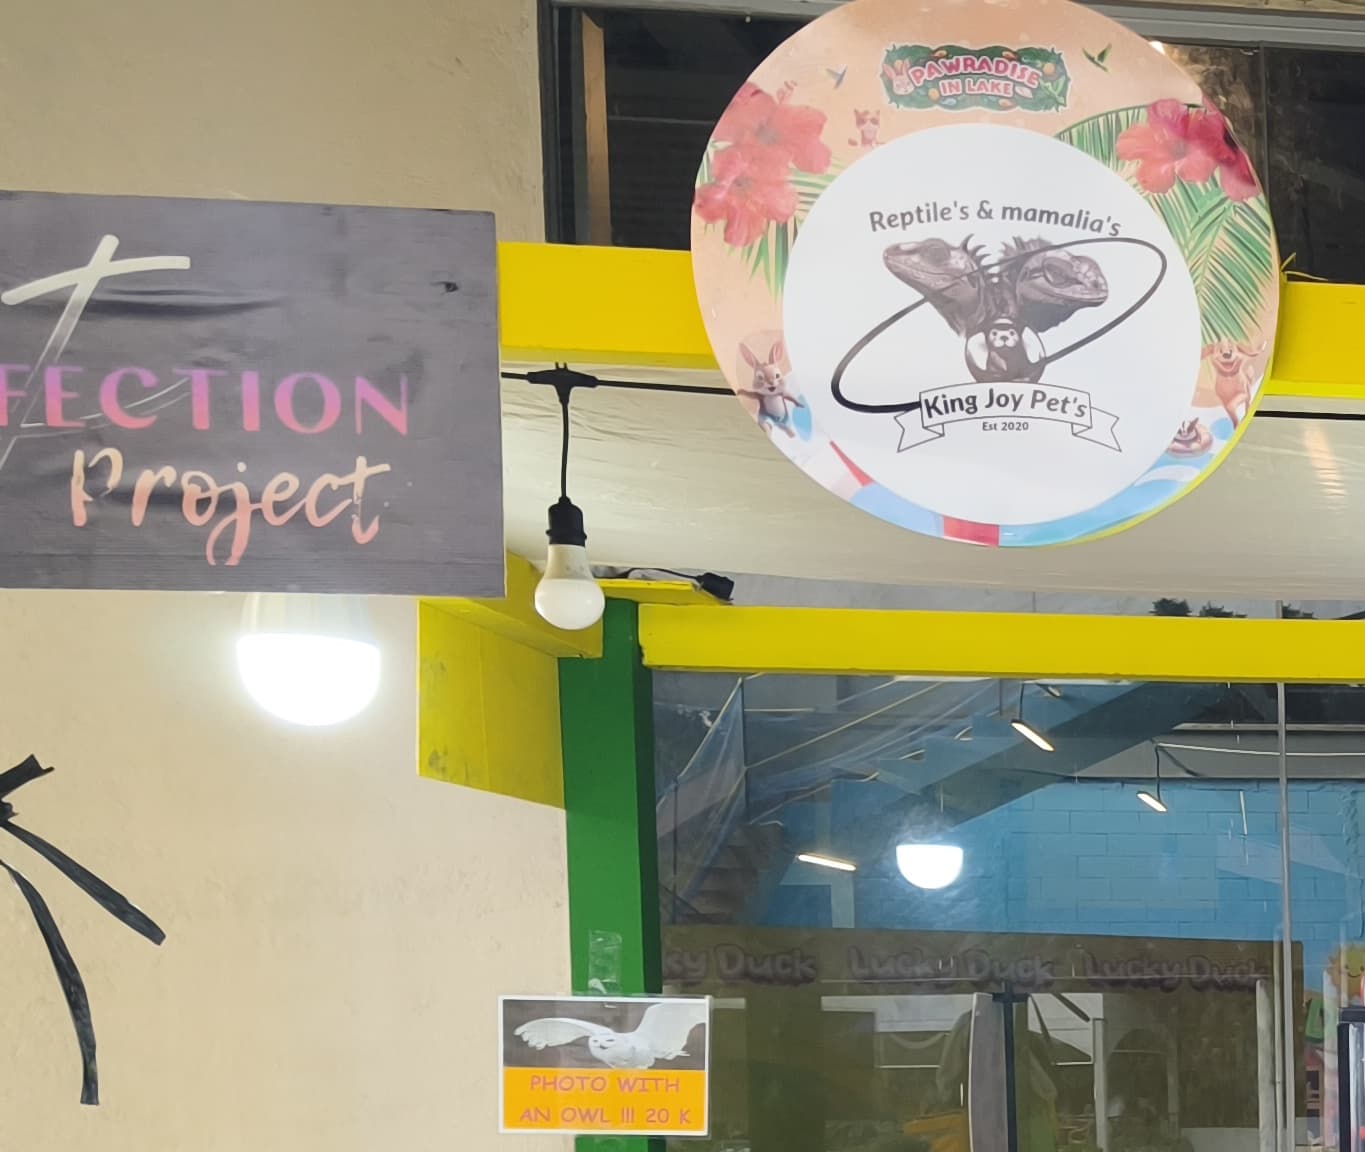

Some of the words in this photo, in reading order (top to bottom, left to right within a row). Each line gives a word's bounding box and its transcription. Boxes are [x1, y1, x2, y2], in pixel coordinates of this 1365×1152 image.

[910, 56, 1042, 86] PAWRADISE
[941, 81, 962, 95] IN
[967, 80, 1013, 96] LAKE
[869, 200, 970, 232] Reptile's
[977, 199, 993, 220] &
[1001, 204, 1121, 237] mamalia's
[924, 394, 978, 419] King
[985, 388, 1024, 411] Joy
[1030, 389, 1088, 418] Pet's
[982, 422, 998, 431] Est
[1001, 422, 1029, 431] 2020
[71, 447, 391, 566] Project
[530, 1075, 607, 1093] PHOTO
[617, 1076, 680, 1093] WITH
[520, 1107, 550, 1122] AN
[561, 1107, 611, 1123] OWL
[645, 1108, 669, 1124] 20
[679, 1108, 691, 1125] K
